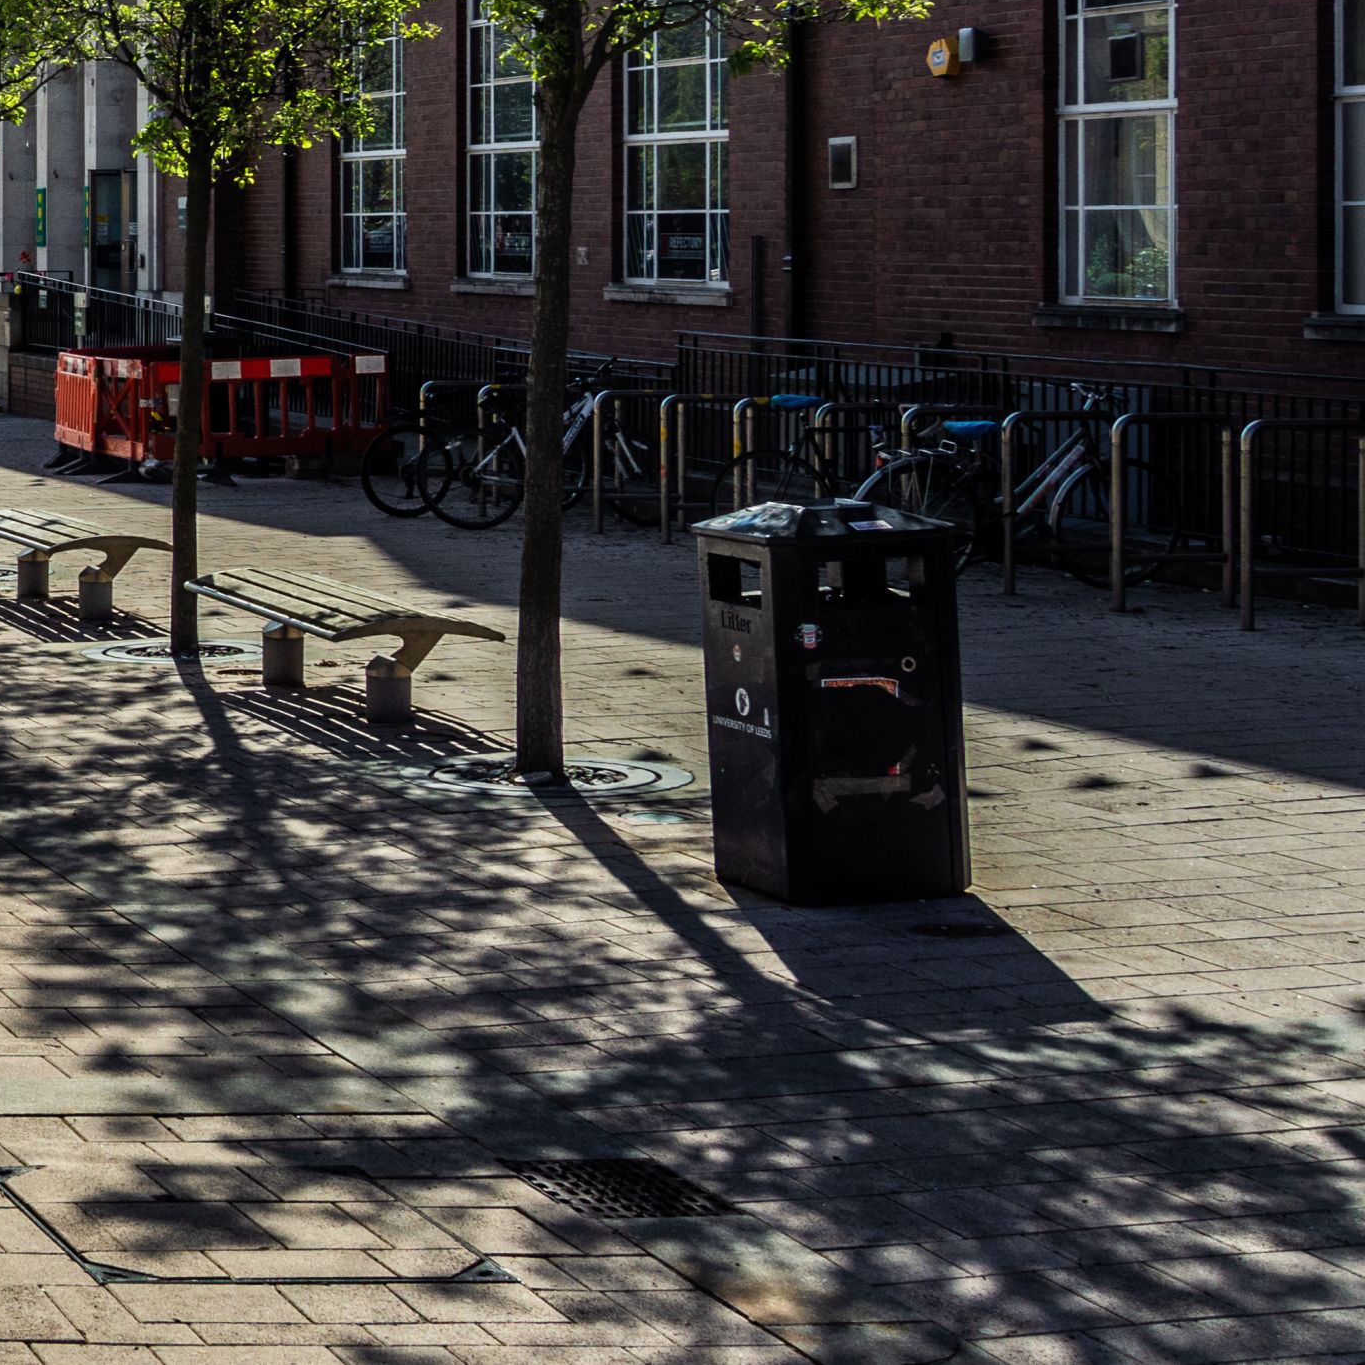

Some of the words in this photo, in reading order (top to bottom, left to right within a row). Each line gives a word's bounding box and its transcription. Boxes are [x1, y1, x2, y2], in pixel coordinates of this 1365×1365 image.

[721, 609, 752, 634] Litter
[713, 714, 746, 733] UNIVERSITY
[746, 724, 755, 734] OF
[754, 725, 772, 739] LEEDS
